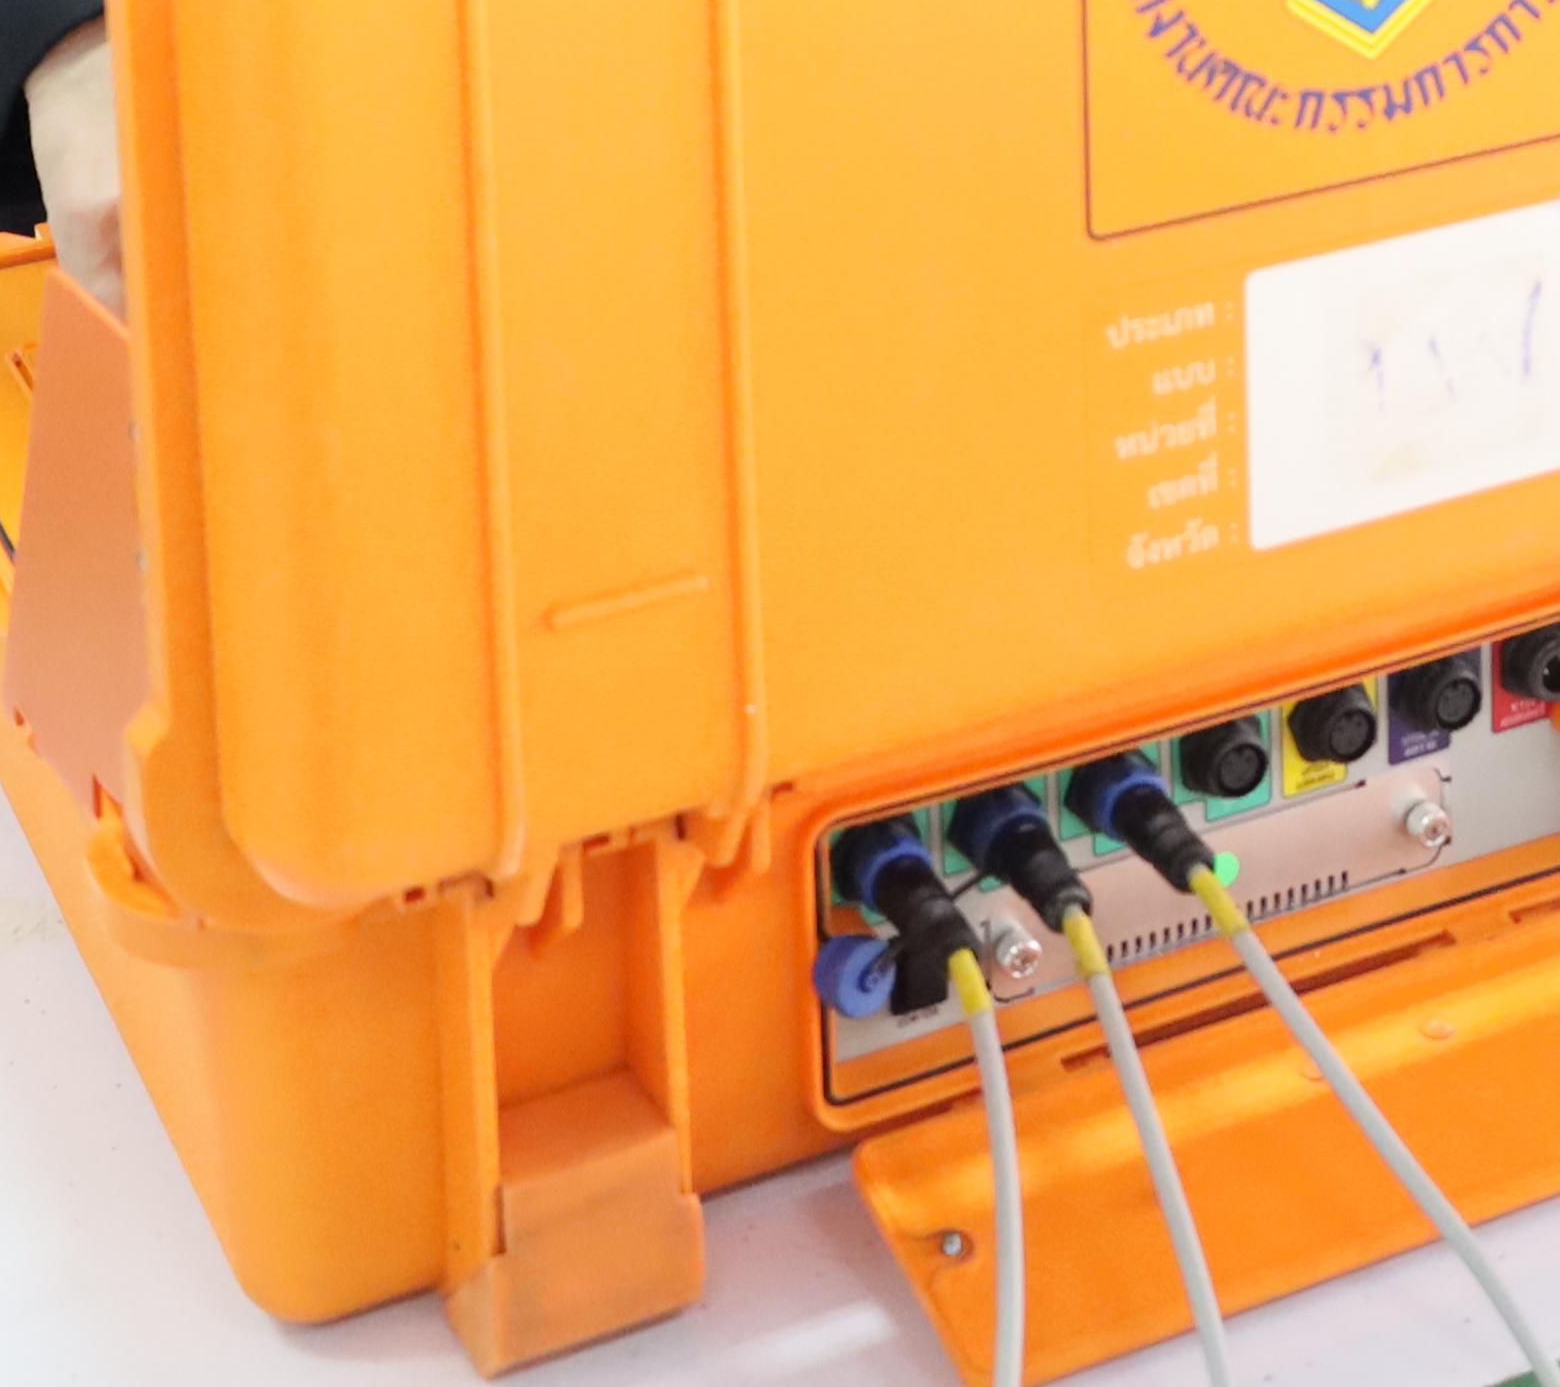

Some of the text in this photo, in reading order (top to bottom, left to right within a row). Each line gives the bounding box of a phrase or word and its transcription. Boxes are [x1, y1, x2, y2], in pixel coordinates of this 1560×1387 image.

[1106, 300, 1216, 350] ประเภท
[1152, 356, 1217, 396] แบบ
[1113, 394, 1218, 461] หน่วยที่
[1126, 515, 1220, 571] จังหวัด
